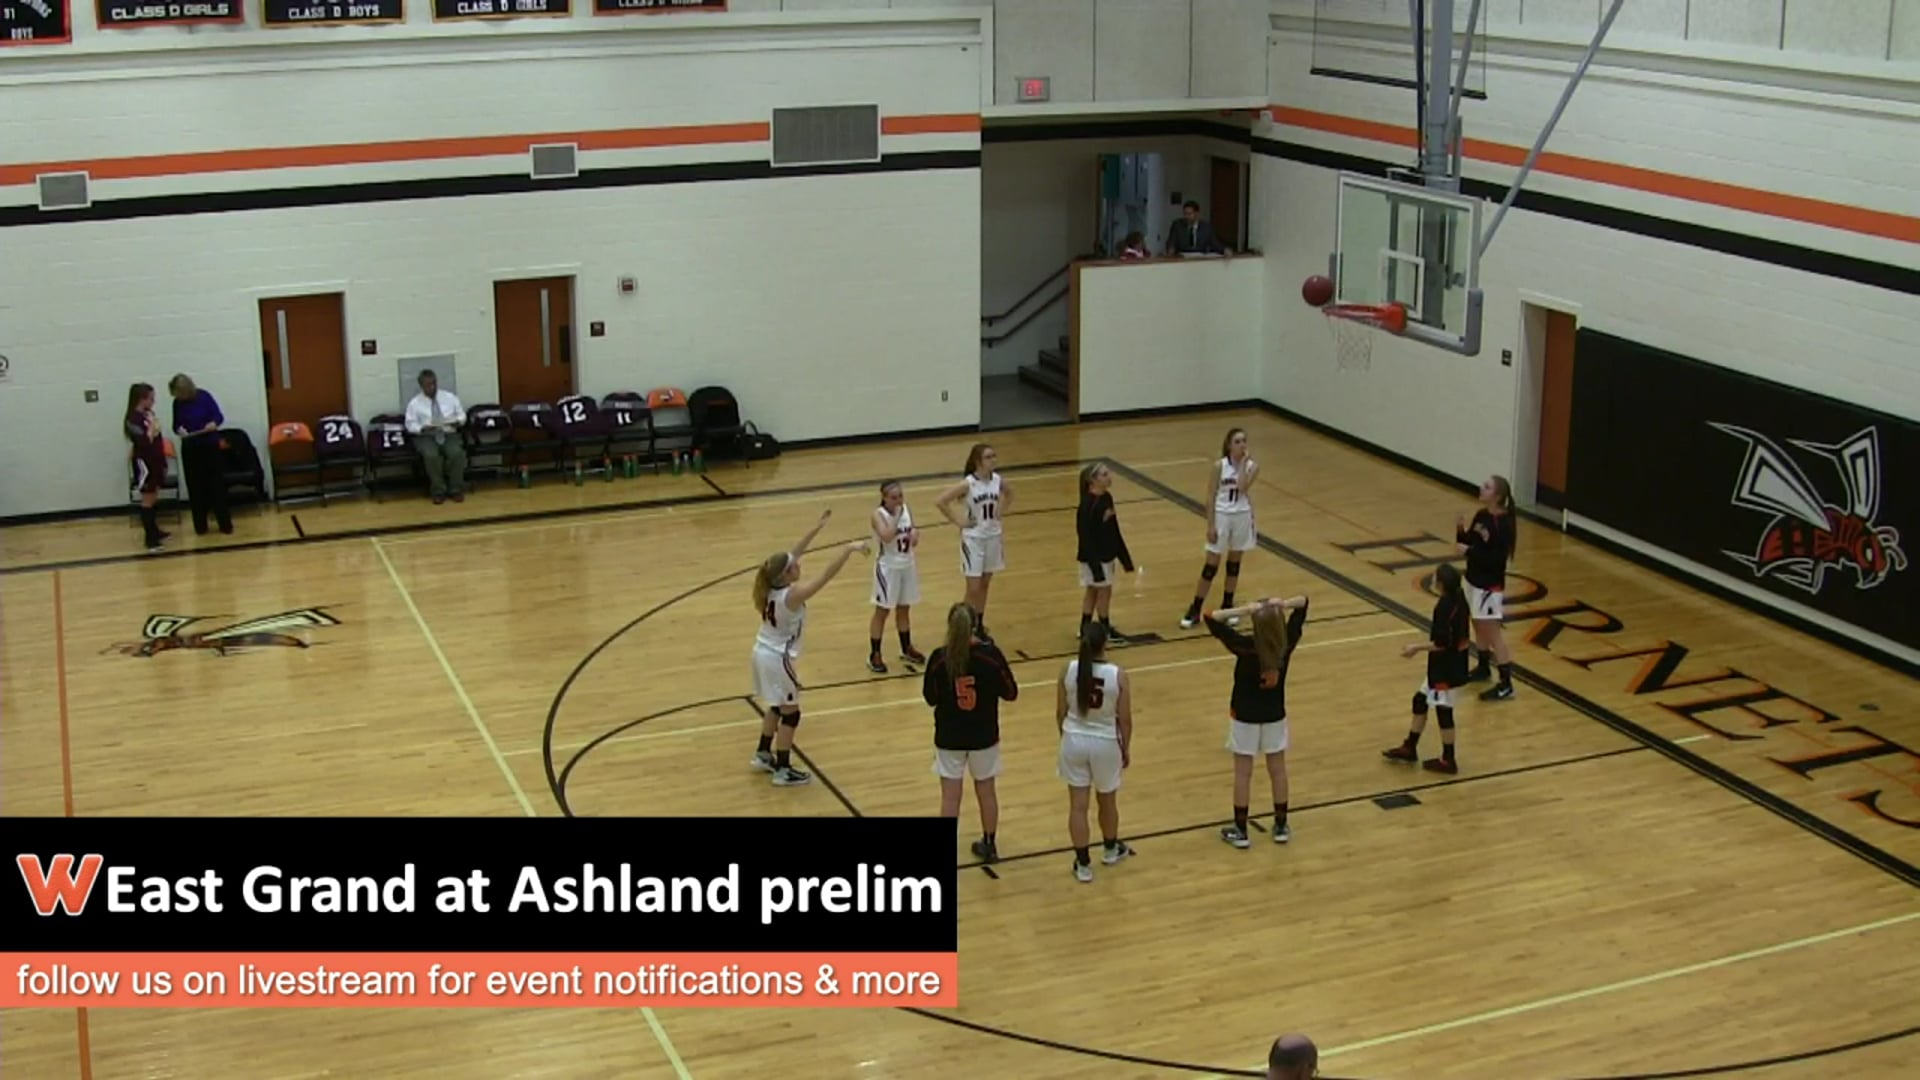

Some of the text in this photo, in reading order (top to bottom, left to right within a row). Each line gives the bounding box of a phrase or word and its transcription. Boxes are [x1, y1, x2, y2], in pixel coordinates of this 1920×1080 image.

[112, 3, 229, 20] CLASS D GIRLS
[288, 4, 380, 20] CLASS D BOYS
[458, 2, 493, 13] CLASS
[11, 27, 34, 41] BOYS
[561, 401, 587, 424] 12
[323, 421, 354, 444] 24
[954, 675, 977, 711] 5
